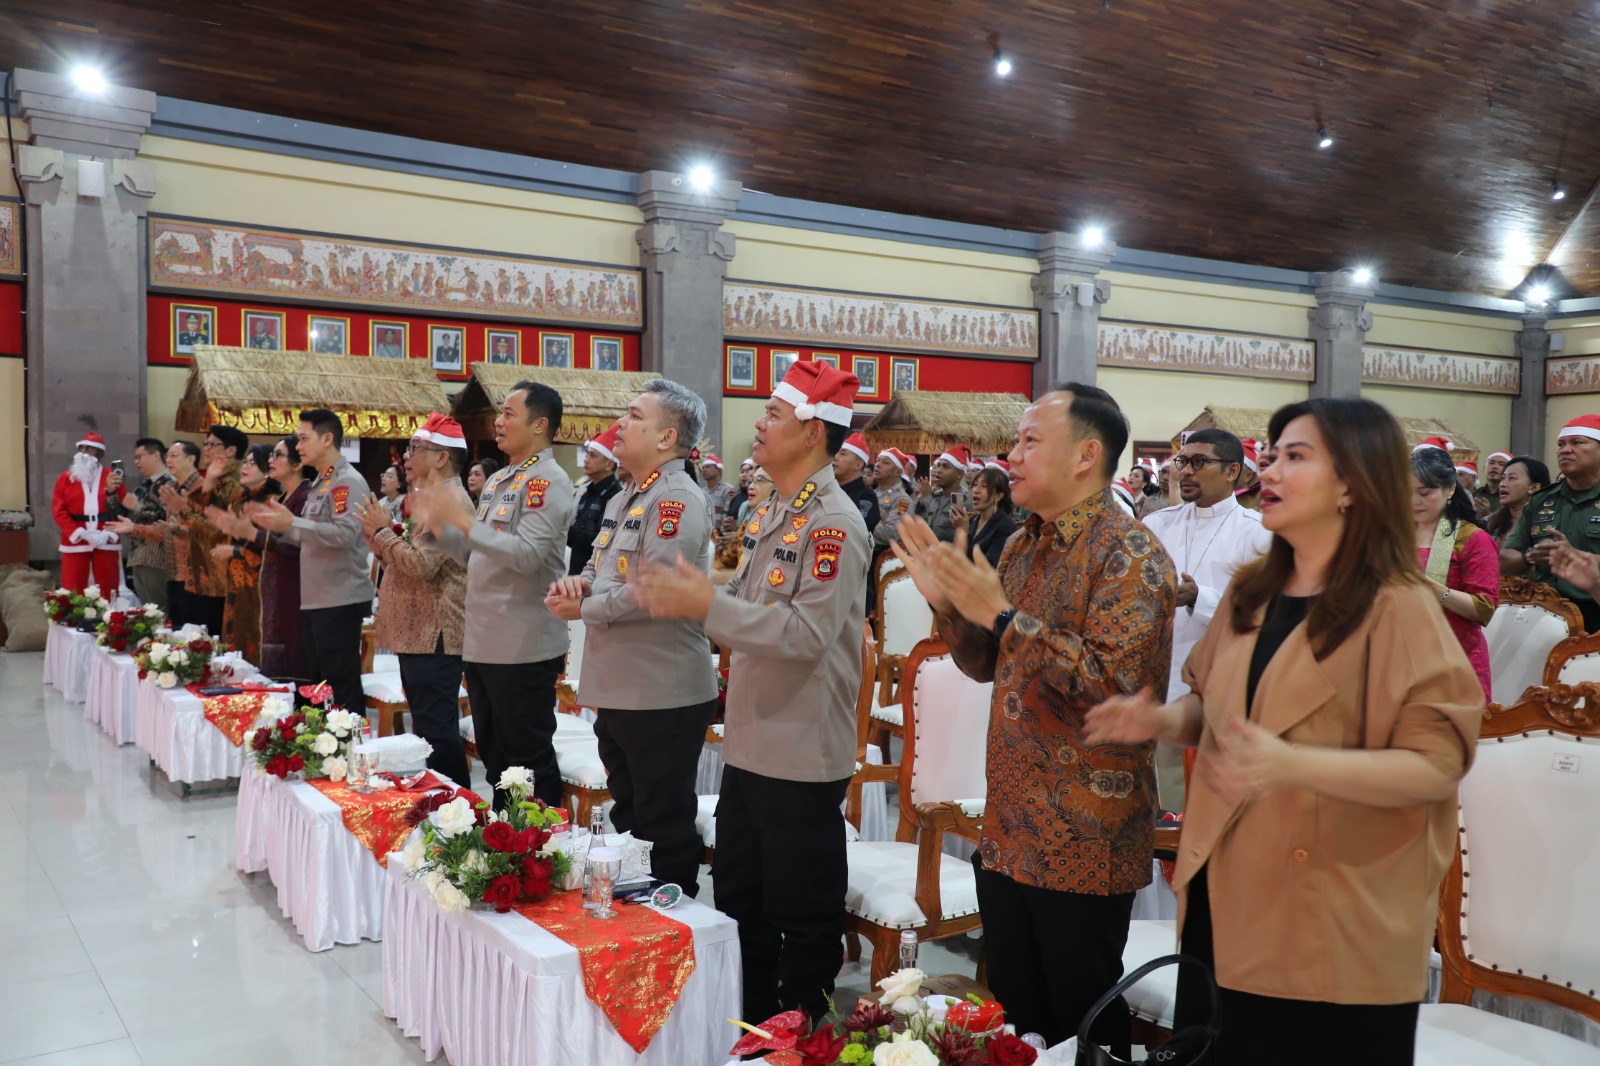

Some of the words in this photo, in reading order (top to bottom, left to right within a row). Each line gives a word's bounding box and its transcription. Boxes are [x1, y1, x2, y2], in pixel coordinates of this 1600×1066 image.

[502, 493, 516, 502] POLRI
[660, 501, 683, 509] POLDA
[623, 519, 641, 530] POLRI
[813, 529, 843, 539] POLDA
[773, 547, 797, 564] POLRI
